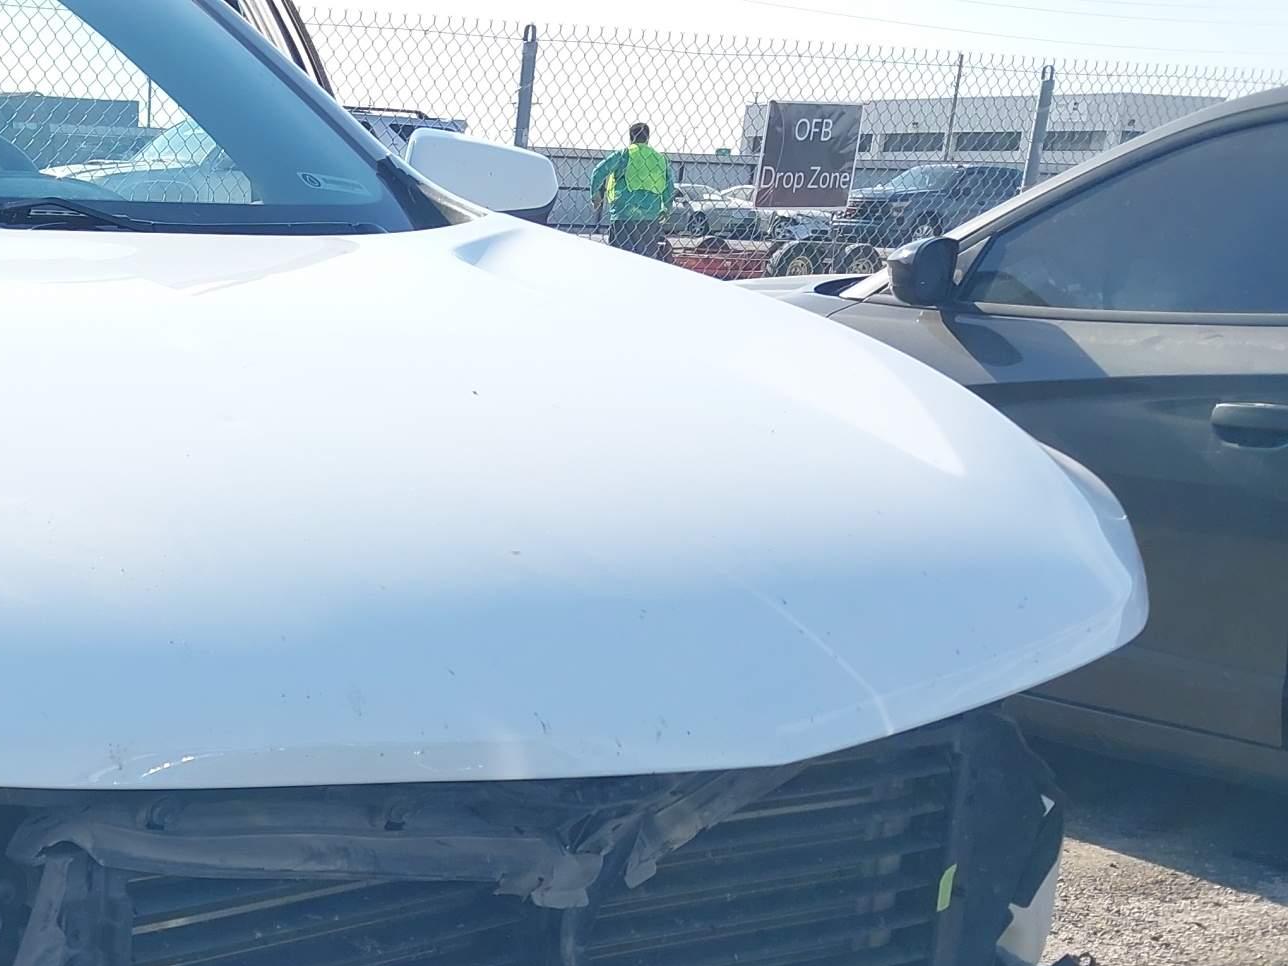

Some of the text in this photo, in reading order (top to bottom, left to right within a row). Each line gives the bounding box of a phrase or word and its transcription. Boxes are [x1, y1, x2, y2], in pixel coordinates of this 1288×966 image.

[795, 118, 833, 141] OFB
[760, 166, 850, 193] Drop Zone
